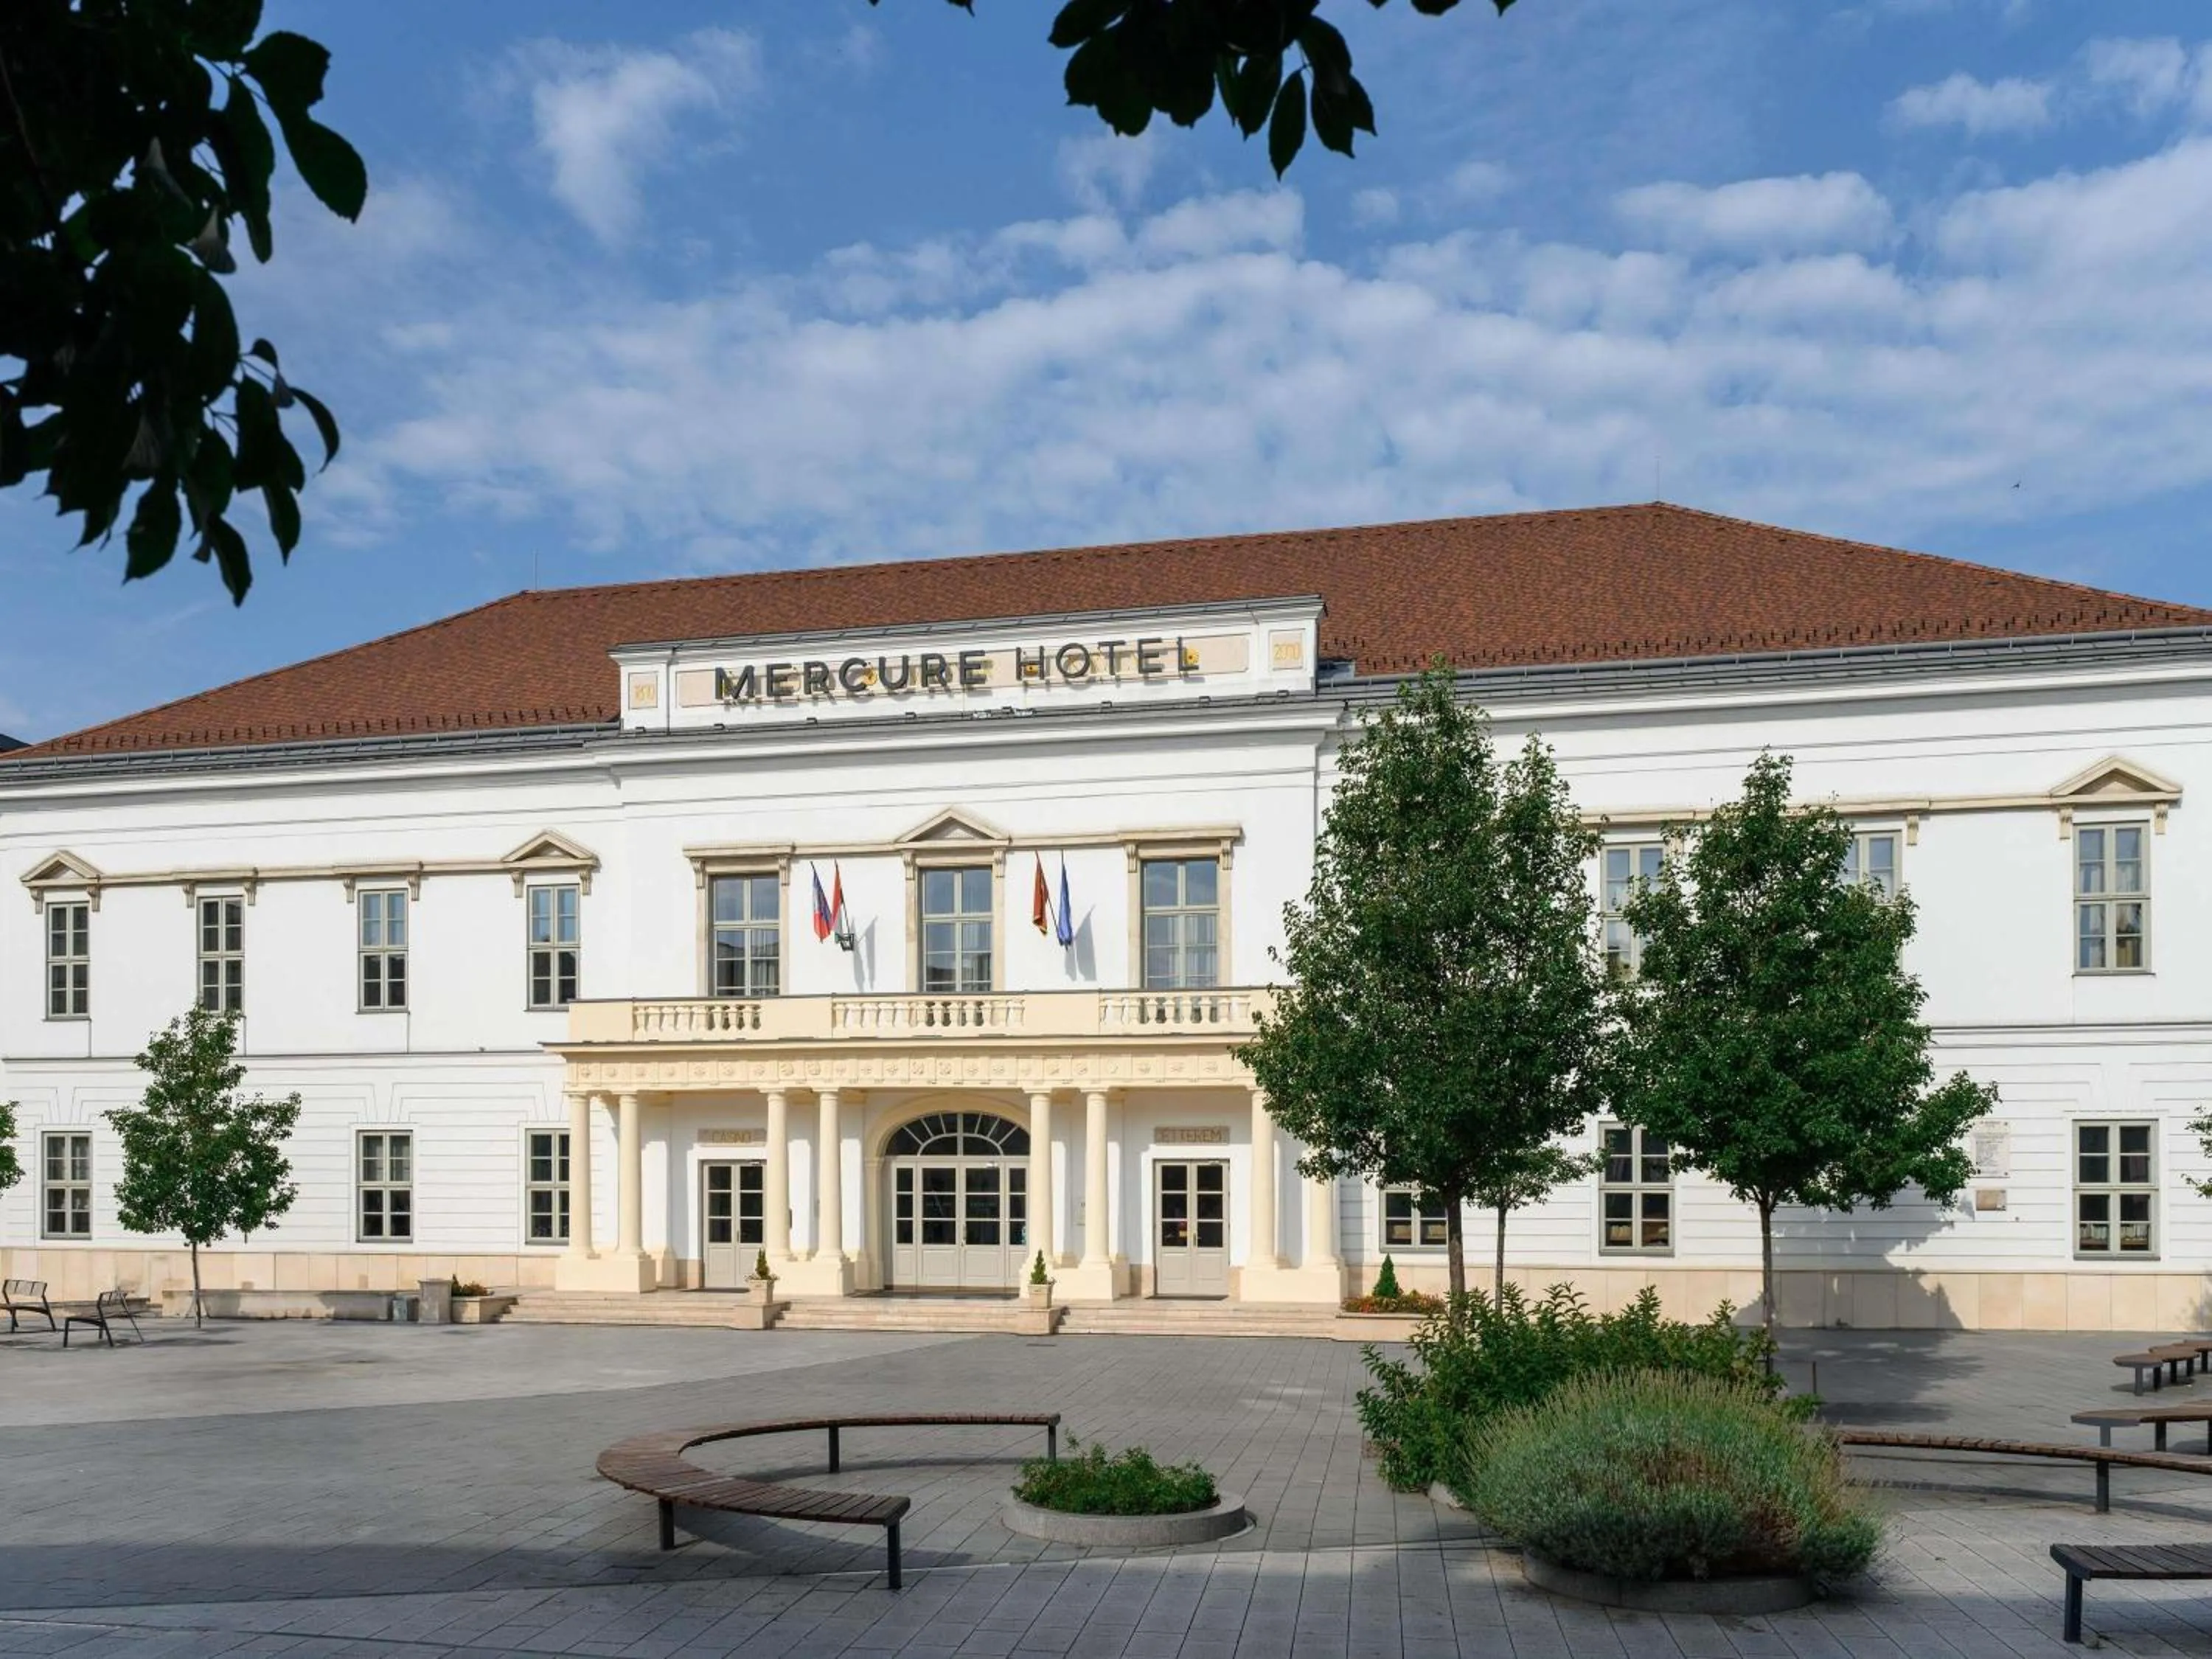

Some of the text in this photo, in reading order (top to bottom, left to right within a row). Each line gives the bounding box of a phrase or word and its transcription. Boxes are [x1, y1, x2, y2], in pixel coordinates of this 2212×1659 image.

[714, 636, 1200, 700] MERCURE HOTEL
[711, 1129, 751, 1144] CASINO
